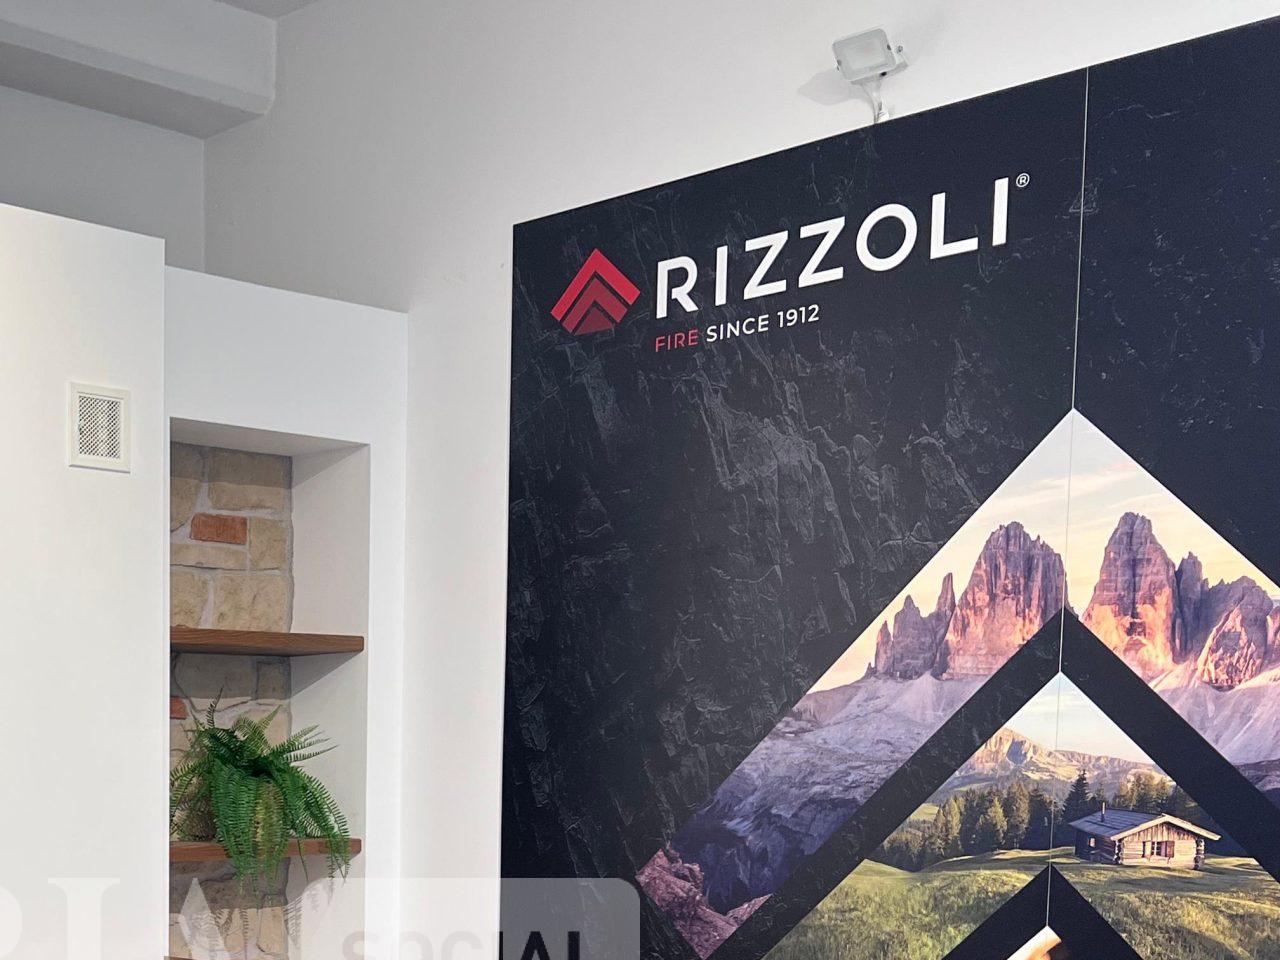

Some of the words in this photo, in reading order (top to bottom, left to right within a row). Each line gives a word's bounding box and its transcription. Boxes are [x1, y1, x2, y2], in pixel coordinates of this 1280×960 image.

[656, 177, 1009, 319] RIZZOLI
[654, 329, 698, 353] FIRE
[706, 314, 769, 343] SINCE
[777, 304, 820, 329] 1912
